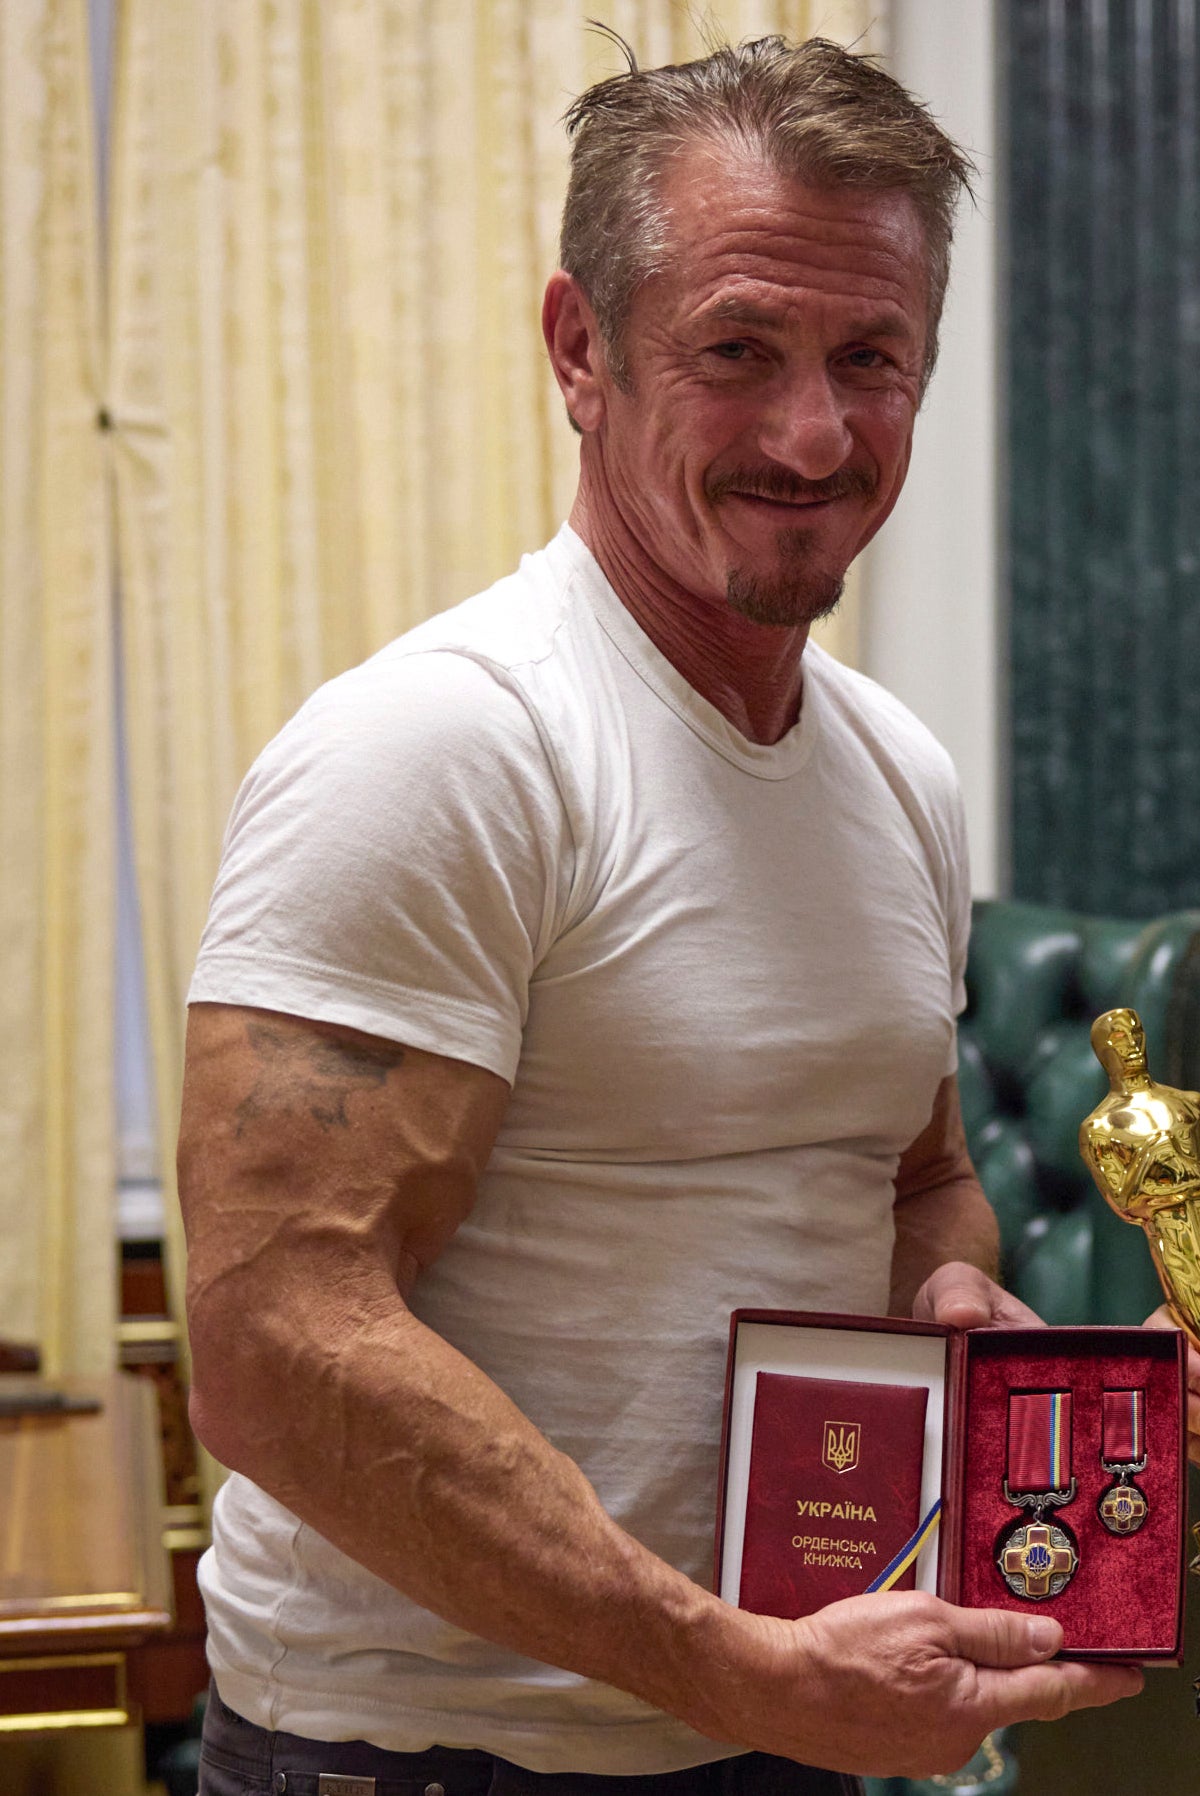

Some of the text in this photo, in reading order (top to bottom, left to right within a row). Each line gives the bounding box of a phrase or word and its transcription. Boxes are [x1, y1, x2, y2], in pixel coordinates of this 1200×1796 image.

[796, 1500, 877, 1522] УКРАЇНА
[791, 1535, 877, 1555] ОРДЕНСЬКА
[803, 1552, 863, 1569] КНИЖКА
